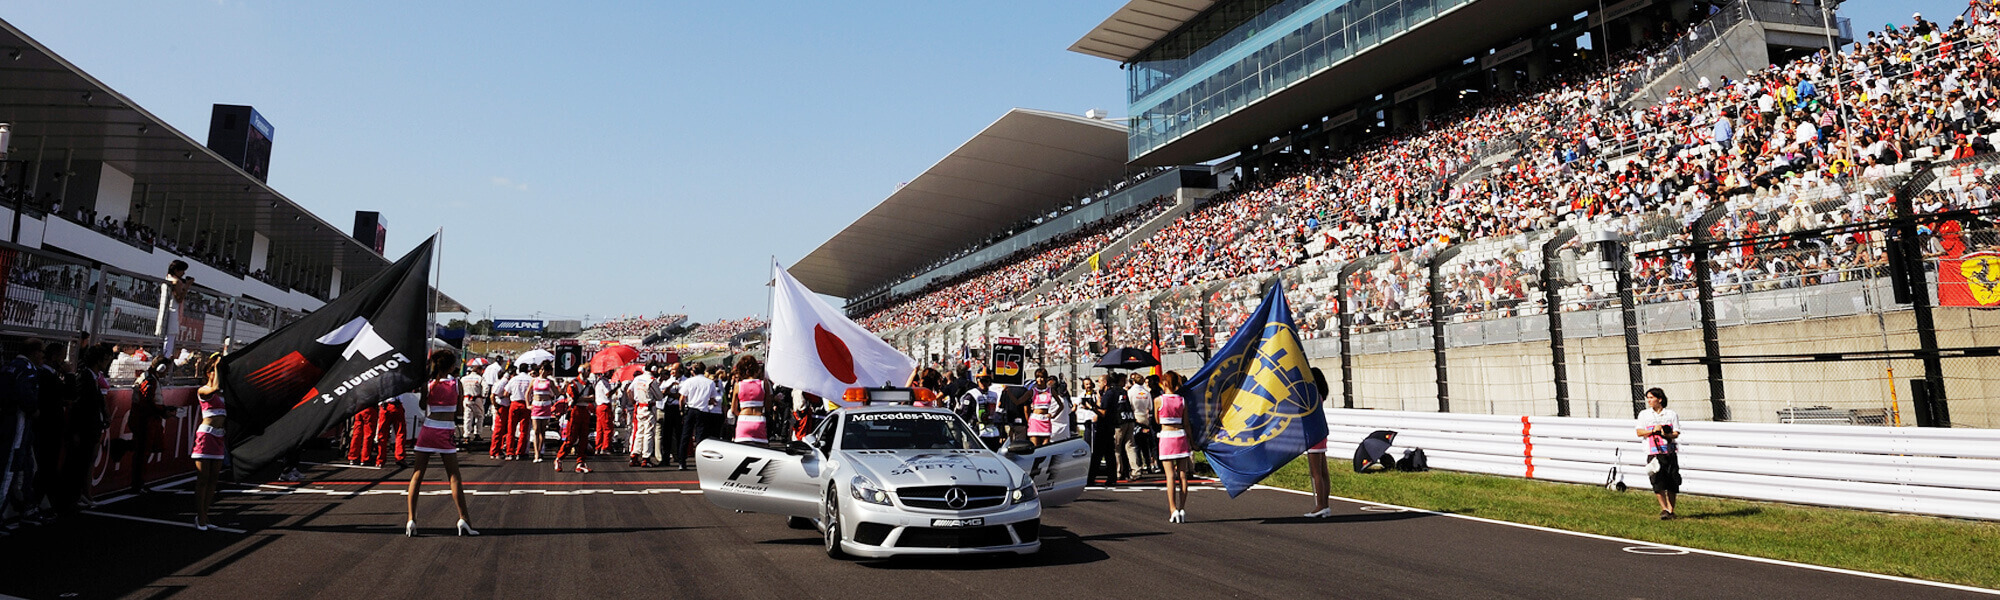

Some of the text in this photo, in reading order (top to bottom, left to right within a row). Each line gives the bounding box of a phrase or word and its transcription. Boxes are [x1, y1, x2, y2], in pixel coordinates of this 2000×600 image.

[508, 321, 540, 329] ALPINE
[995, 353, 1021, 376] 15
[852, 412, 955, 422] Mercedes-Benz
[891, 463, 954, 475] SAFETY
[963, 464, 999, 475] CAR
[946, 519, 982, 527] AMG
